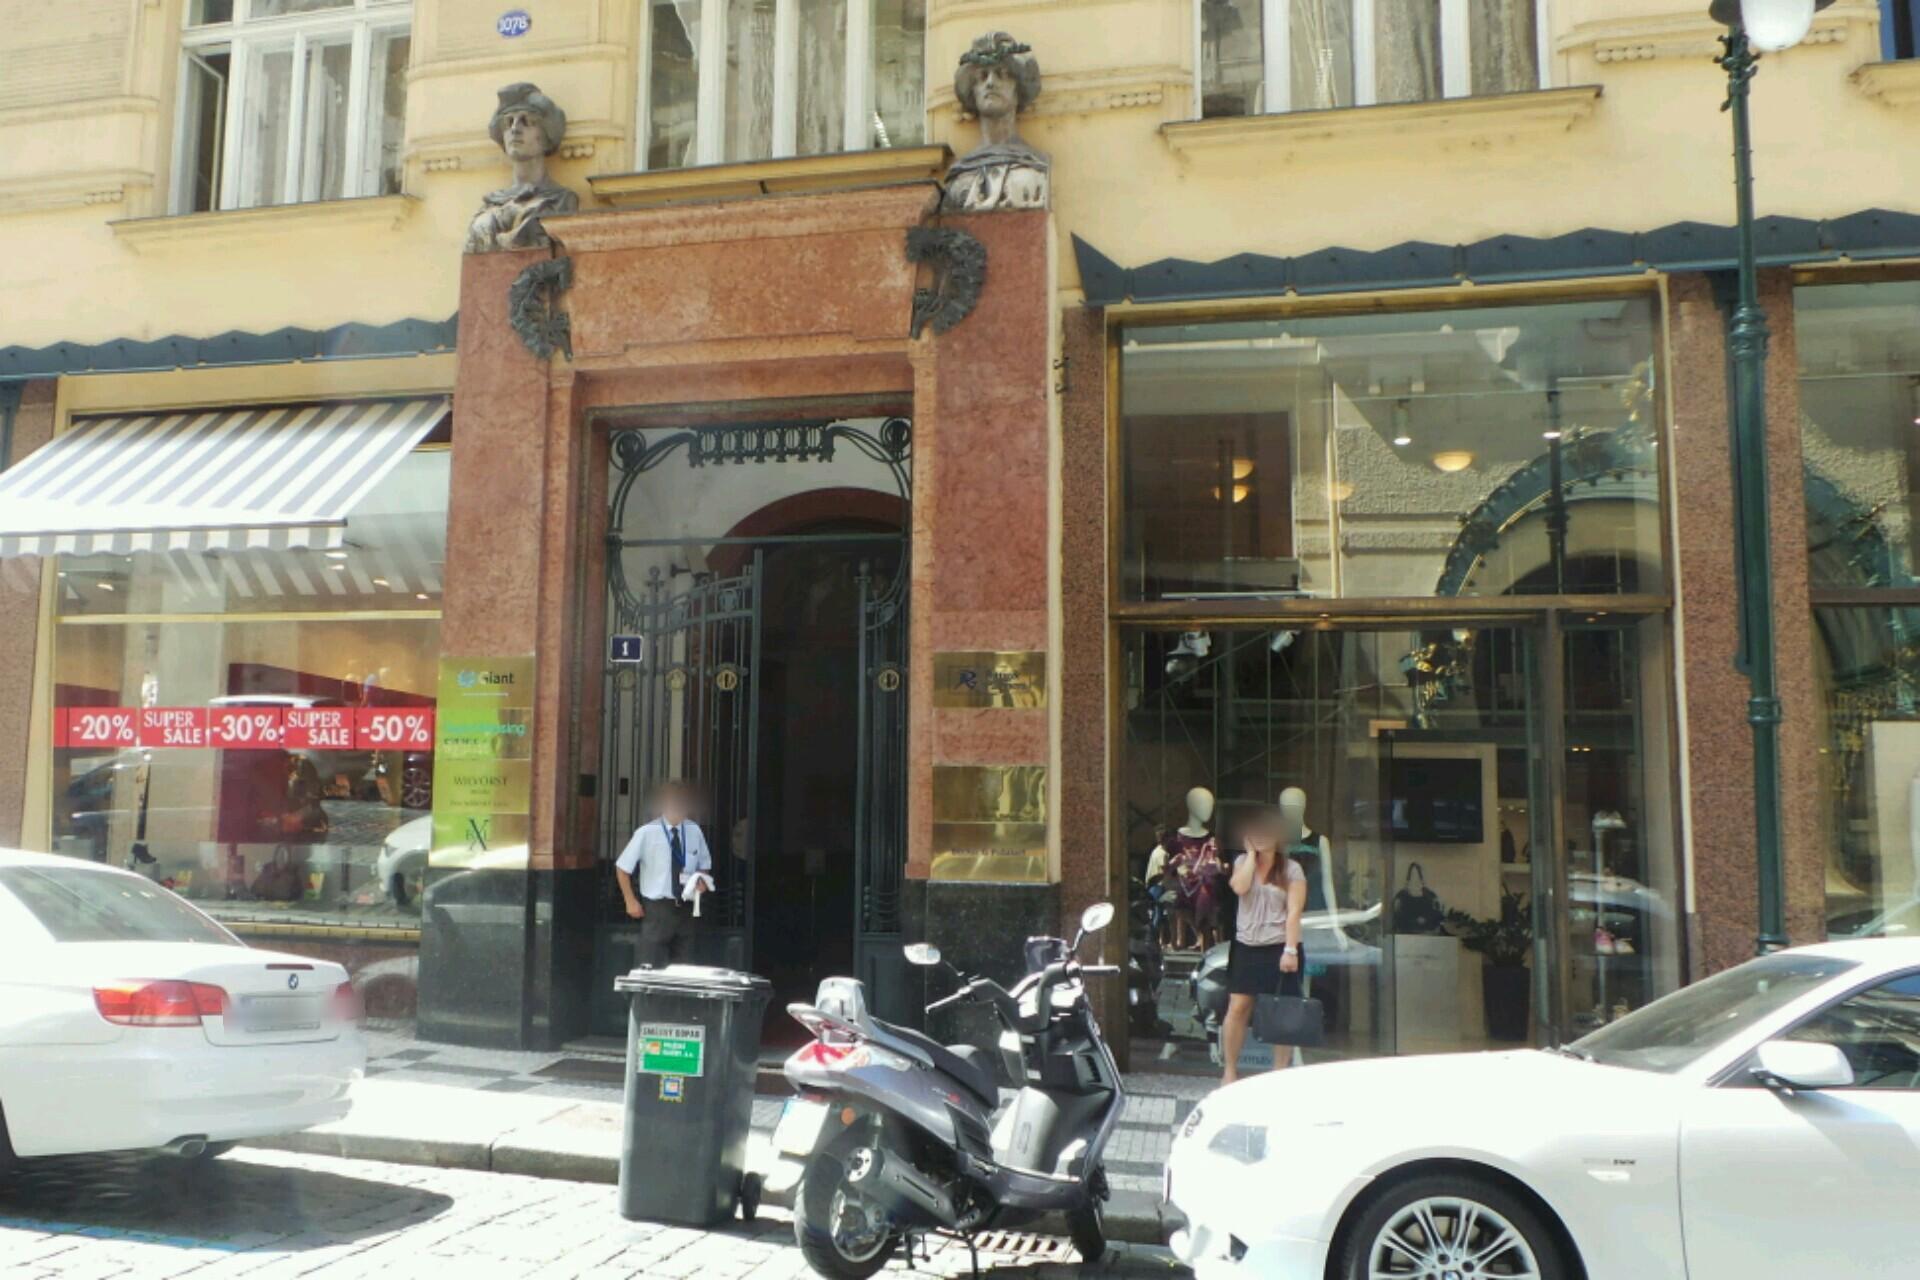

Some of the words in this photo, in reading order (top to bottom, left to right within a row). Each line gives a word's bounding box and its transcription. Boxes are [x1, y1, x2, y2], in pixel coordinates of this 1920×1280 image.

[622, 640, 629, 657] 1
[72, 714, 134, 741] -20%
[143, 711, 195, 728] SUPER
[212, 714, 277, 742] -30%
[287, 711, 342, 728] SUPER
[163, 728, 202, 744] SALE
[307, 728, 350, 745] SALE
[360, 715, 428, 742] -50%
